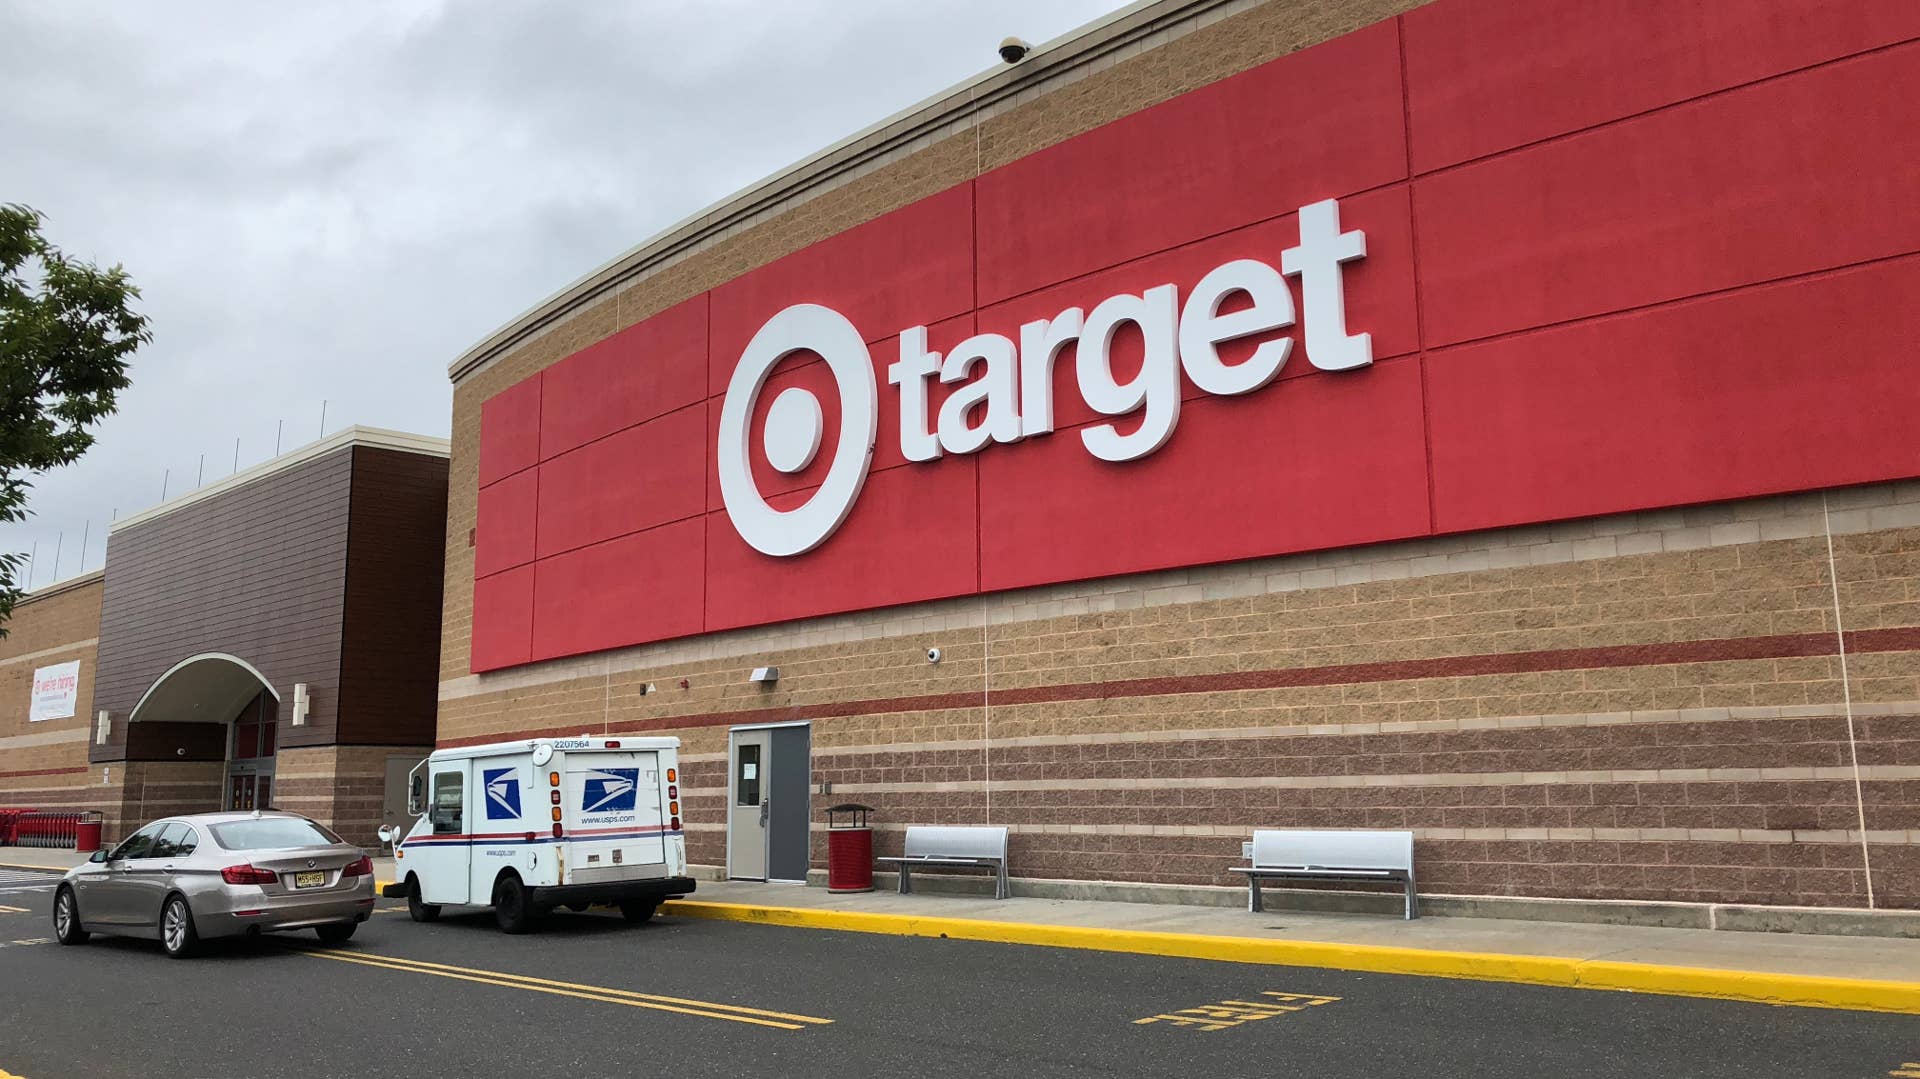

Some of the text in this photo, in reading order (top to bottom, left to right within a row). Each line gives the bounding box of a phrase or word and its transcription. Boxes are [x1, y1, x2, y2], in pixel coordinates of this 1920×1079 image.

[889, 198, 1372, 462] target
[554, 740, 589, 748] 2207564
[581, 816, 635, 825] www.usps.com
